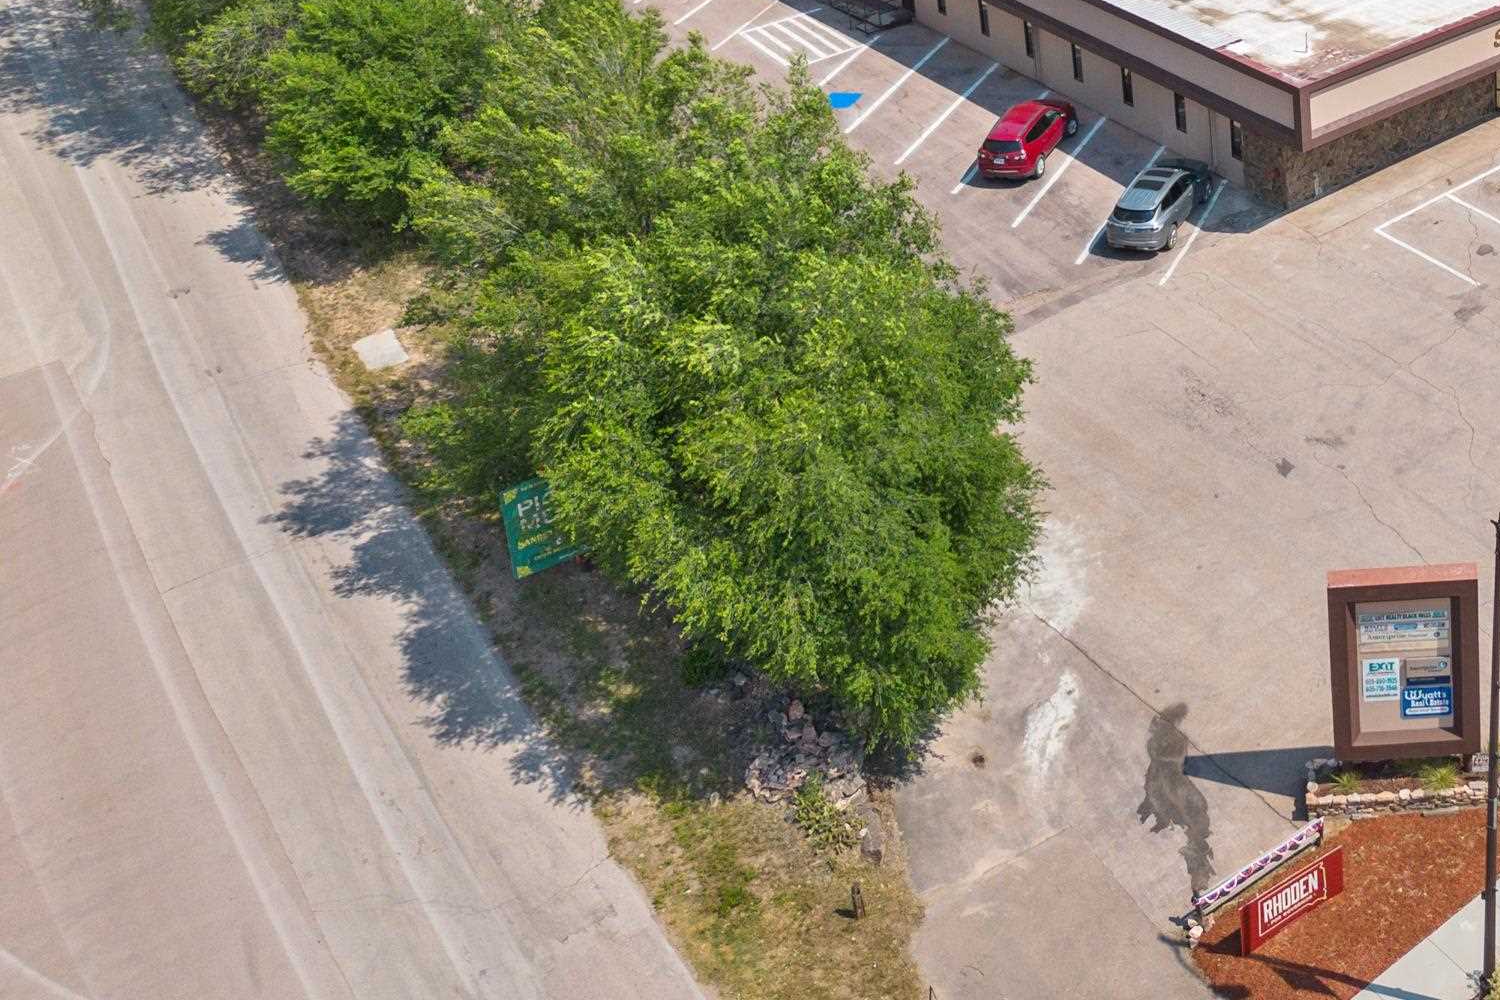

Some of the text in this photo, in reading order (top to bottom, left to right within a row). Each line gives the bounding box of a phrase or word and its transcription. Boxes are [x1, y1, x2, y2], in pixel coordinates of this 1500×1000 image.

[1369, 662, 1395, 672] EXIT
[1404, 689, 1447, 702] Wyatt's
[1411, 699, 1425, 707] Real
[1262, 869, 1319, 923] RHODEN
